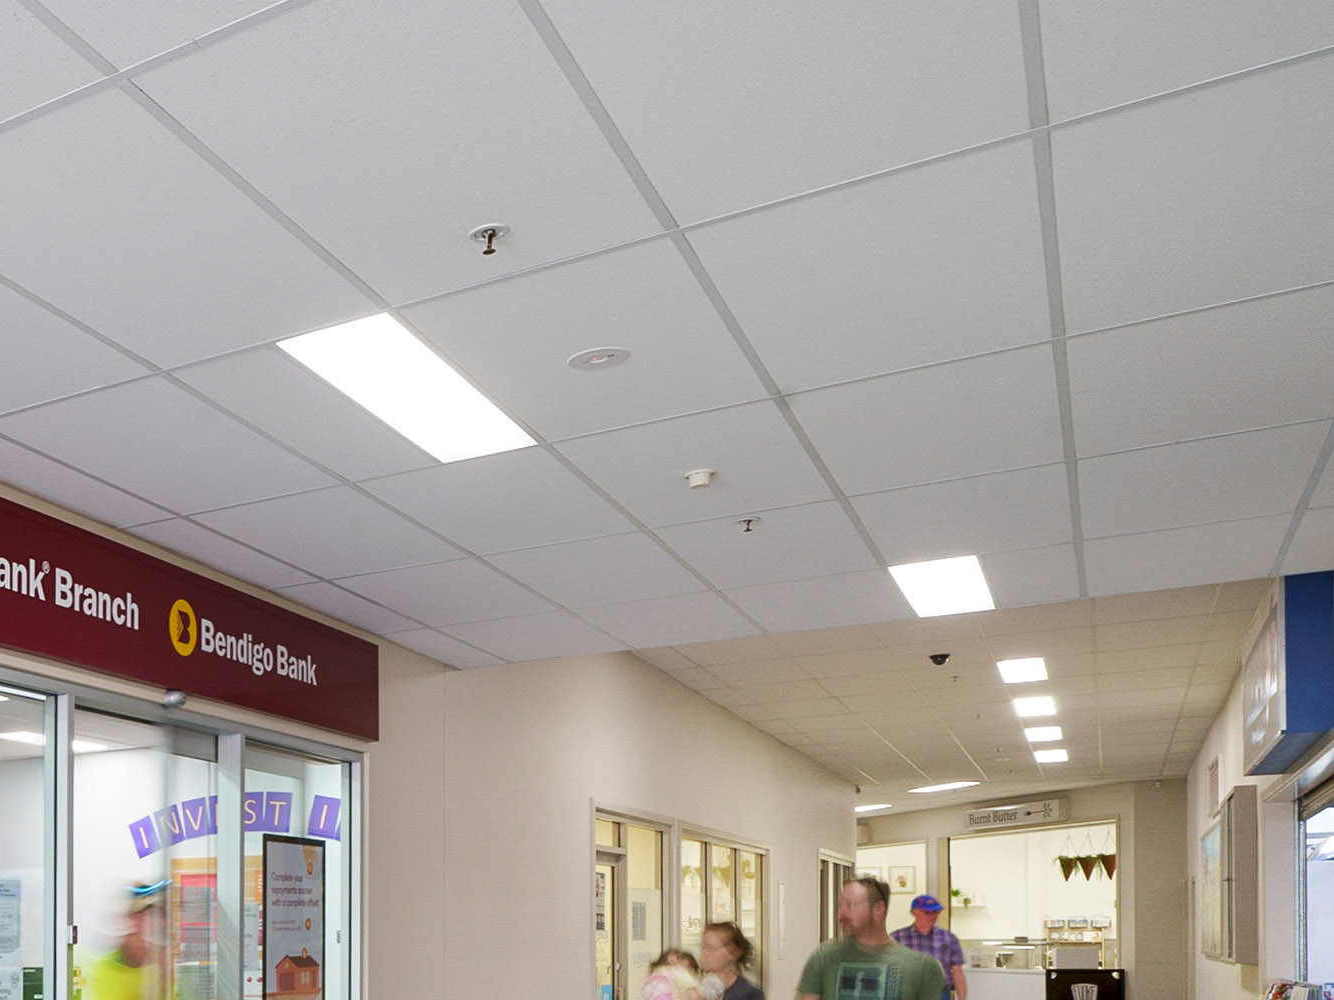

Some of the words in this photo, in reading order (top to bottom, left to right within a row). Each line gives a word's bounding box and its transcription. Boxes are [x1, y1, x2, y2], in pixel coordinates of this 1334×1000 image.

[55, 568, 140, 631] Branch
[201, 618, 273, 676] Bendigo
[276, 643, 318, 687] Bank
[139, 799, 287, 849] INVST
[969, 813, 991, 825] Burnt
[993, 810, 1018, 823] Butter
